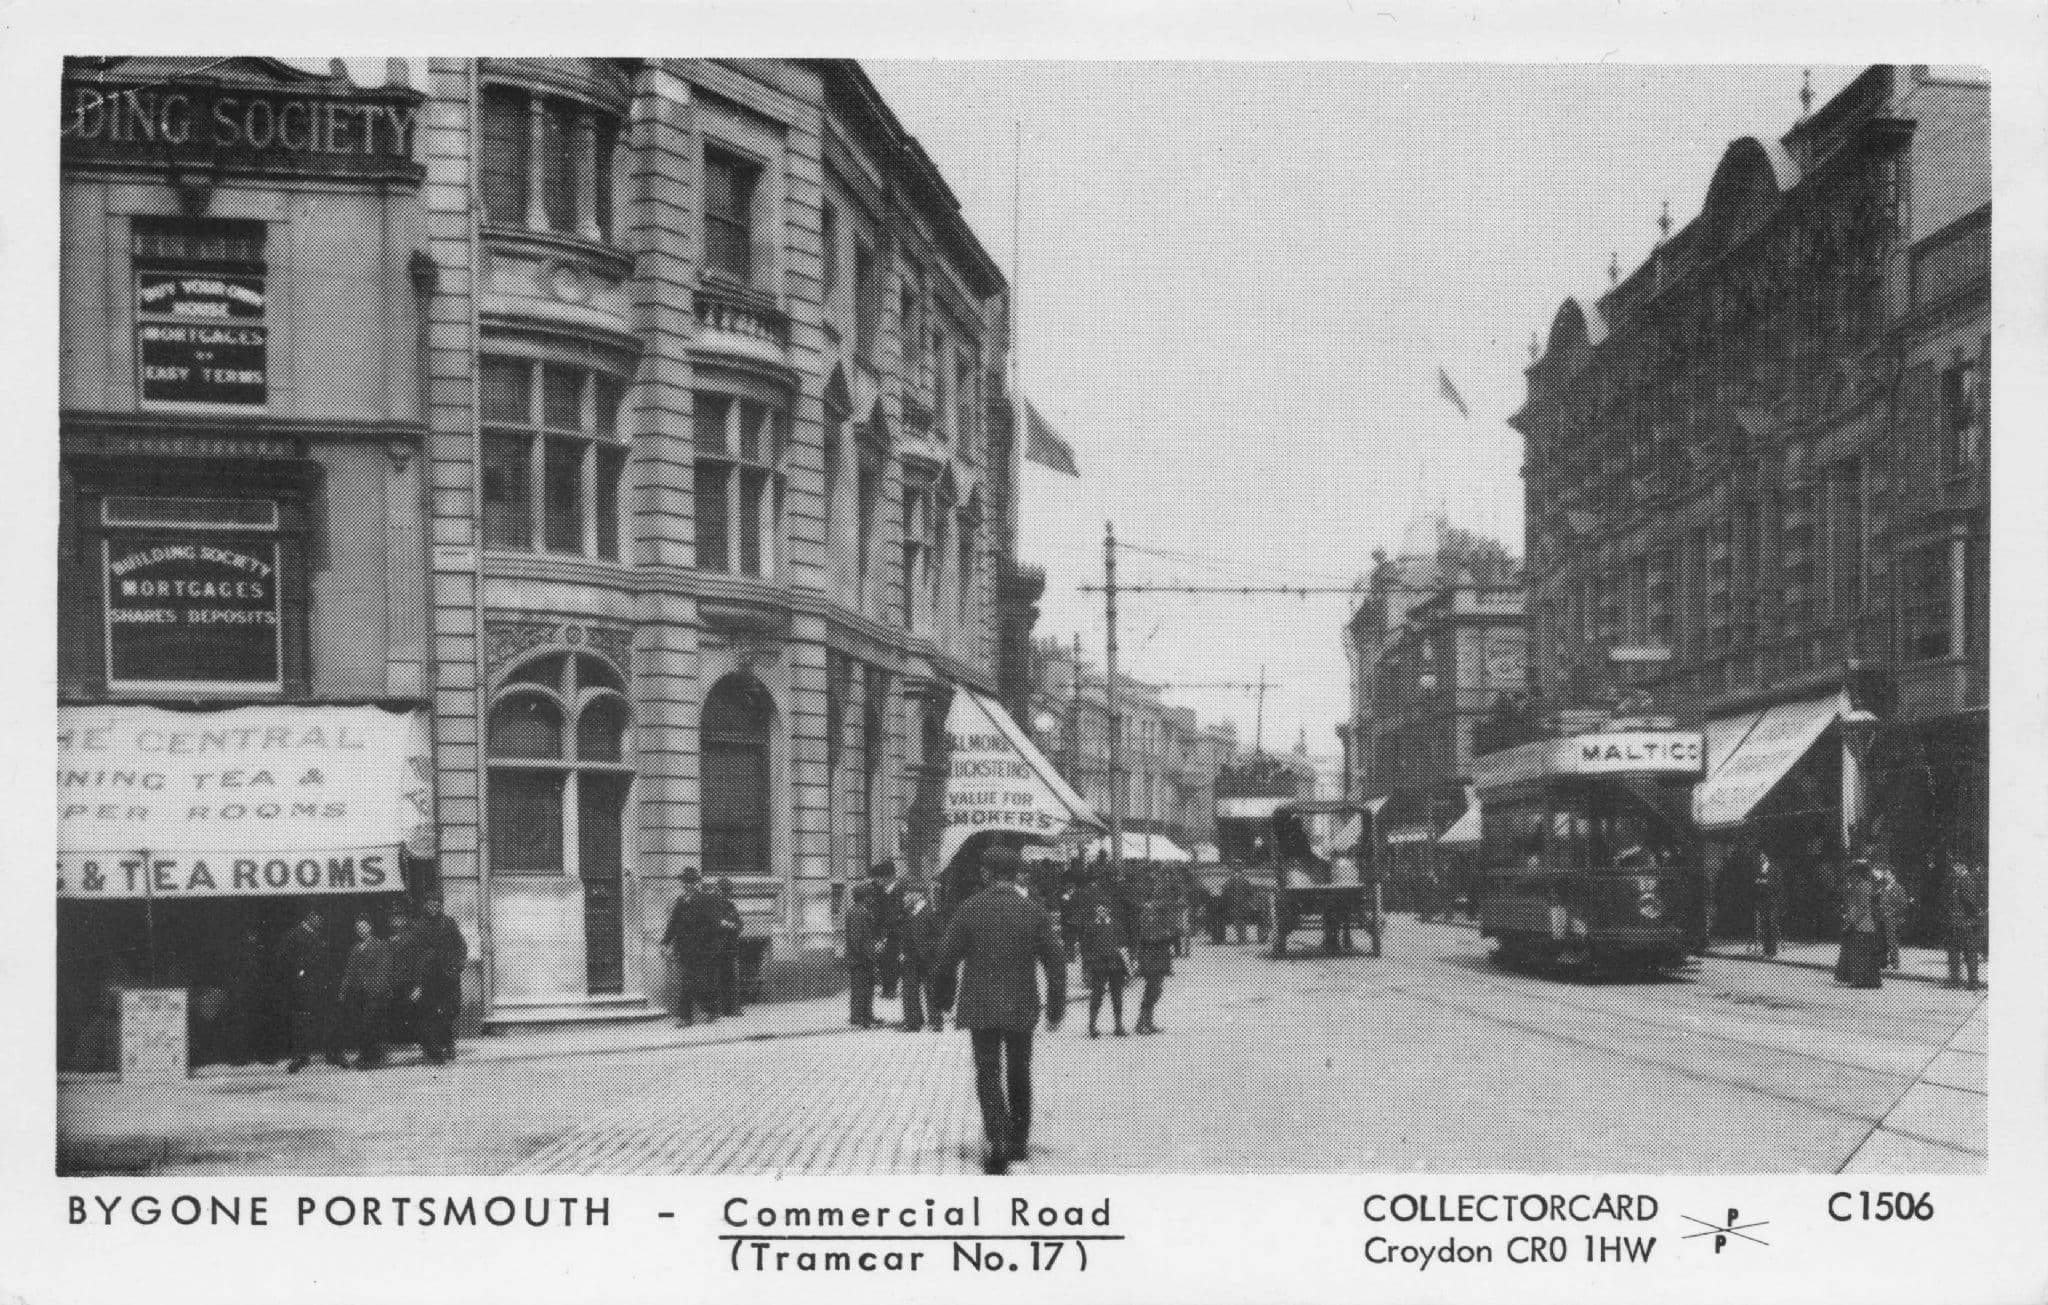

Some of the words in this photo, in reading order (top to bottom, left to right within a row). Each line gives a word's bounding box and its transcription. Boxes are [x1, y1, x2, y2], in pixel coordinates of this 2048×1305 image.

[213, 97, 417, 155] SOCIETY
[144, 325, 264, 346] MORTGAGES
[145, 365, 191, 382] EASY
[202, 367, 264, 384] TERMS
[110, 544, 196, 577] BUILDING
[198, 546, 273, 579] SOCIETY
[121, 579, 266, 599] MORTGAGES
[110, 608, 178, 625] SHARES
[187, 609, 277, 626] DEPOSITS
[136, 725, 365, 756] CENTRAL
[192, 767, 277, 791] TEA
[298, 766, 326, 787] &
[949, 790, 998, 806] VALUE
[1002, 791, 1034, 807] FOR
[187, 801, 348, 821] ROOMS
[82, 859, 107, 891] &
[119, 859, 218, 892] TEA
[233, 855, 388, 890] ROOMS
